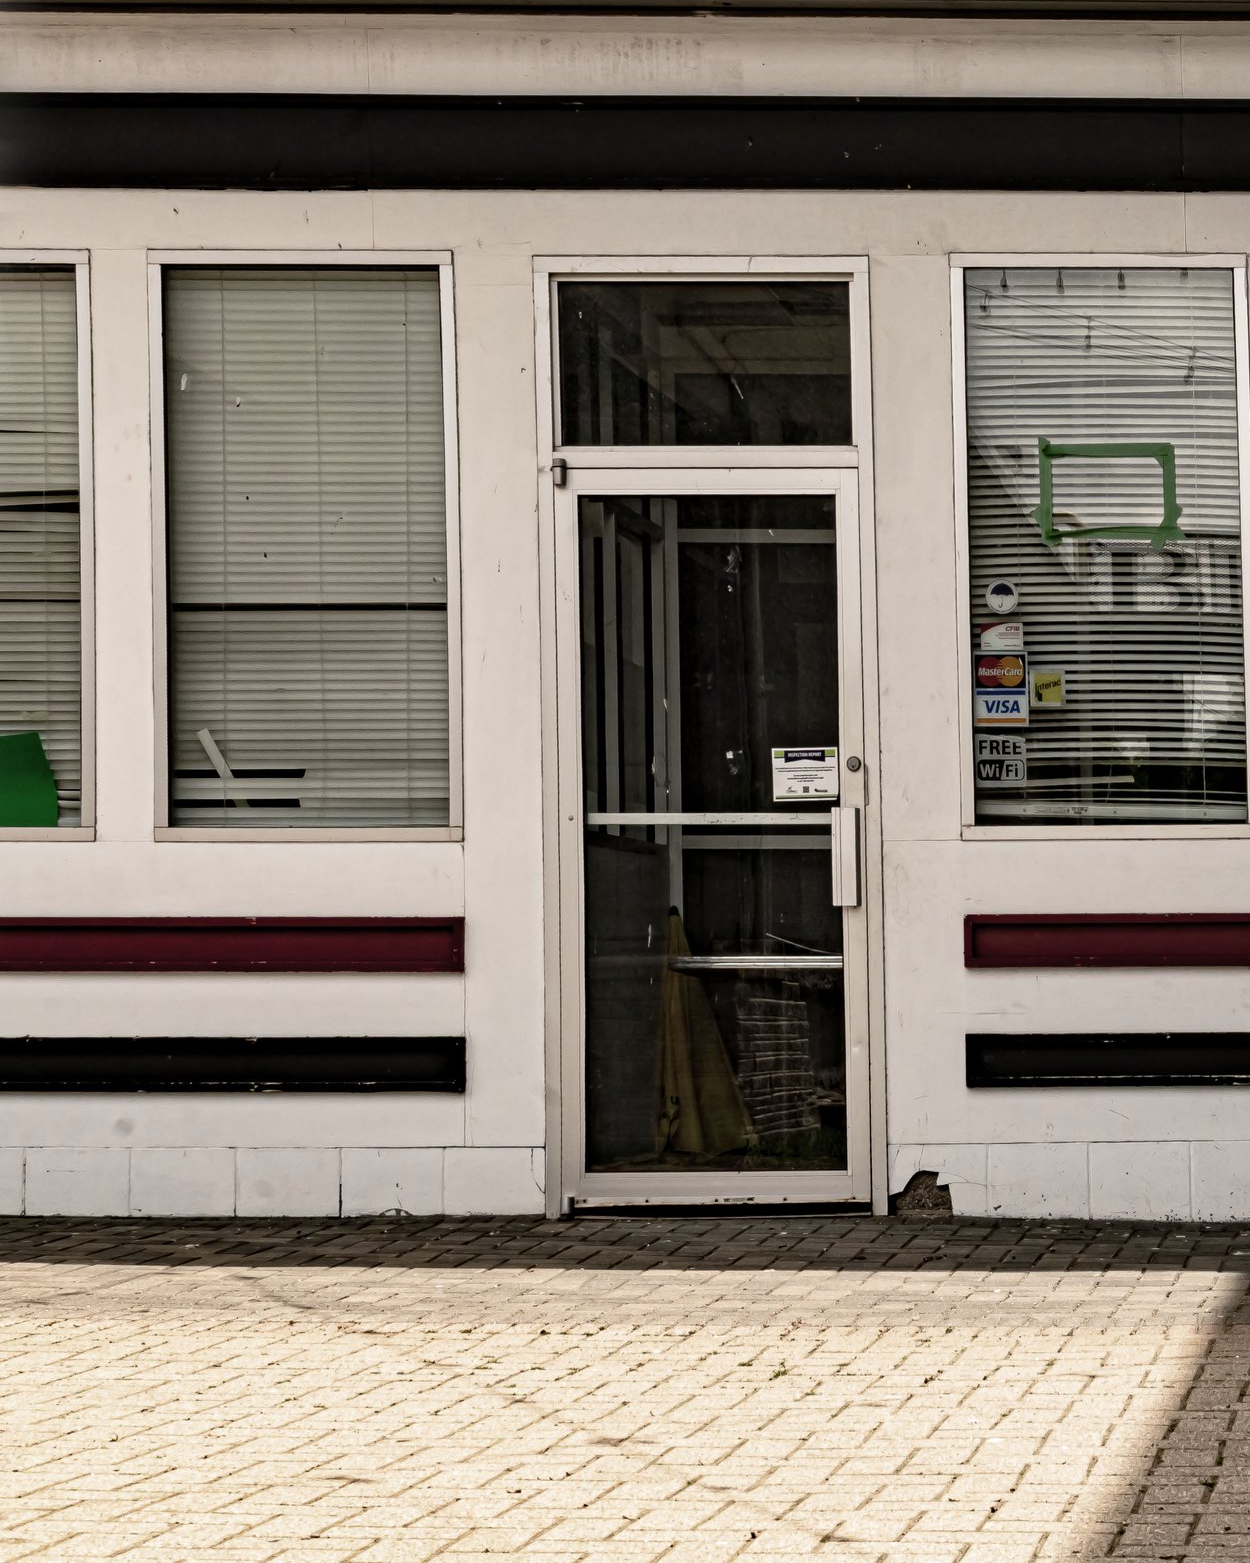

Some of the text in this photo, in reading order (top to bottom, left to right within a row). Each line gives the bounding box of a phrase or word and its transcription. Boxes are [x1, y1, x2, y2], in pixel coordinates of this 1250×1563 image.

[977, 667, 1022, 676] MasterCard
[983, 700, 1020, 713] VISA
[978, 739, 1022, 755] FREE
